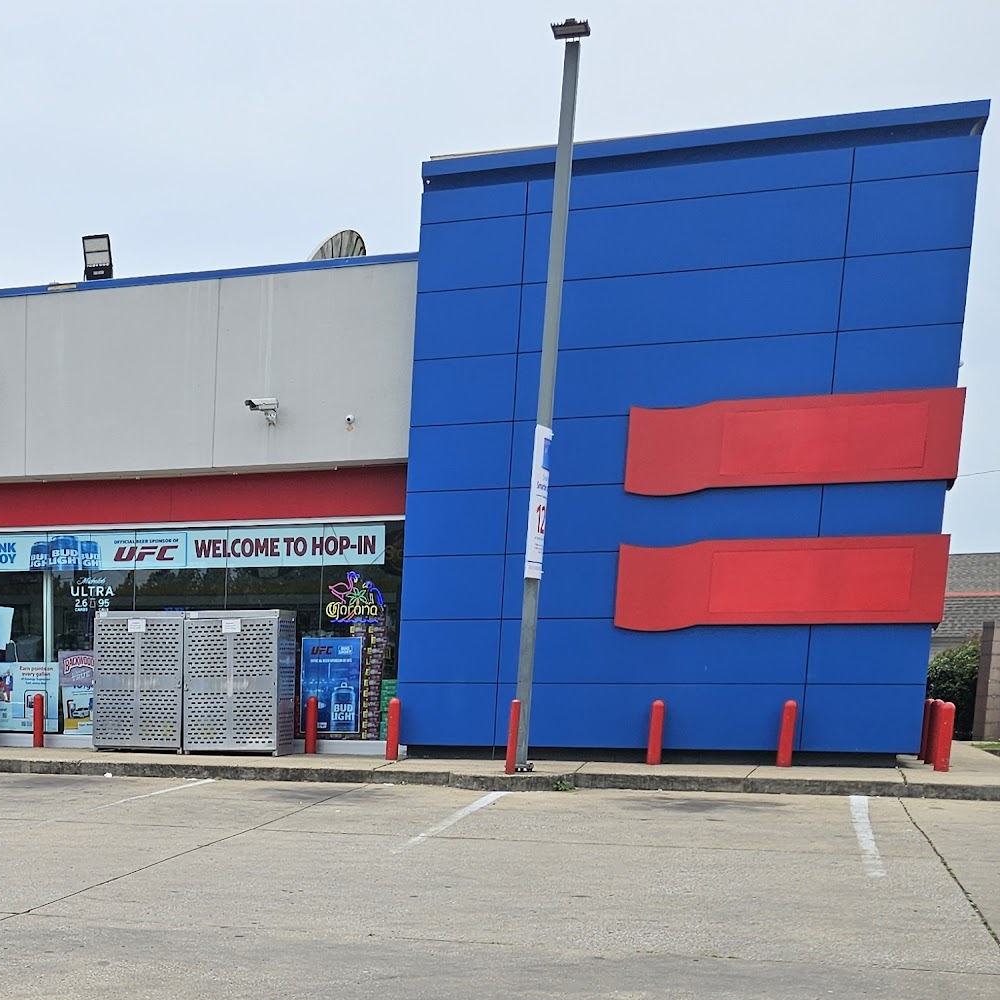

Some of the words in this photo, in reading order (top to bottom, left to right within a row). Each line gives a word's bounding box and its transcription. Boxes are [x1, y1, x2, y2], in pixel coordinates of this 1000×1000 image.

[194, 537, 280, 558] WELCOME
[283, 537, 308, 557] TO
[311, 535, 376, 556] HOP-IN
[52, 549, 79, 557] BUD
[114, 545, 179, 561] UFC
[70, 586, 115, 597] ULTRA
[98, 598, 110, 608] 95
[326, 601, 378, 620] Corona
[311, 646, 333, 655] UFC
[64, 656, 94, 674] BACKWOOD
[71, 670, 91, 681] TRUE
[334, 703, 353, 712] BUD
[331, 712, 355, 721] LIGHT
